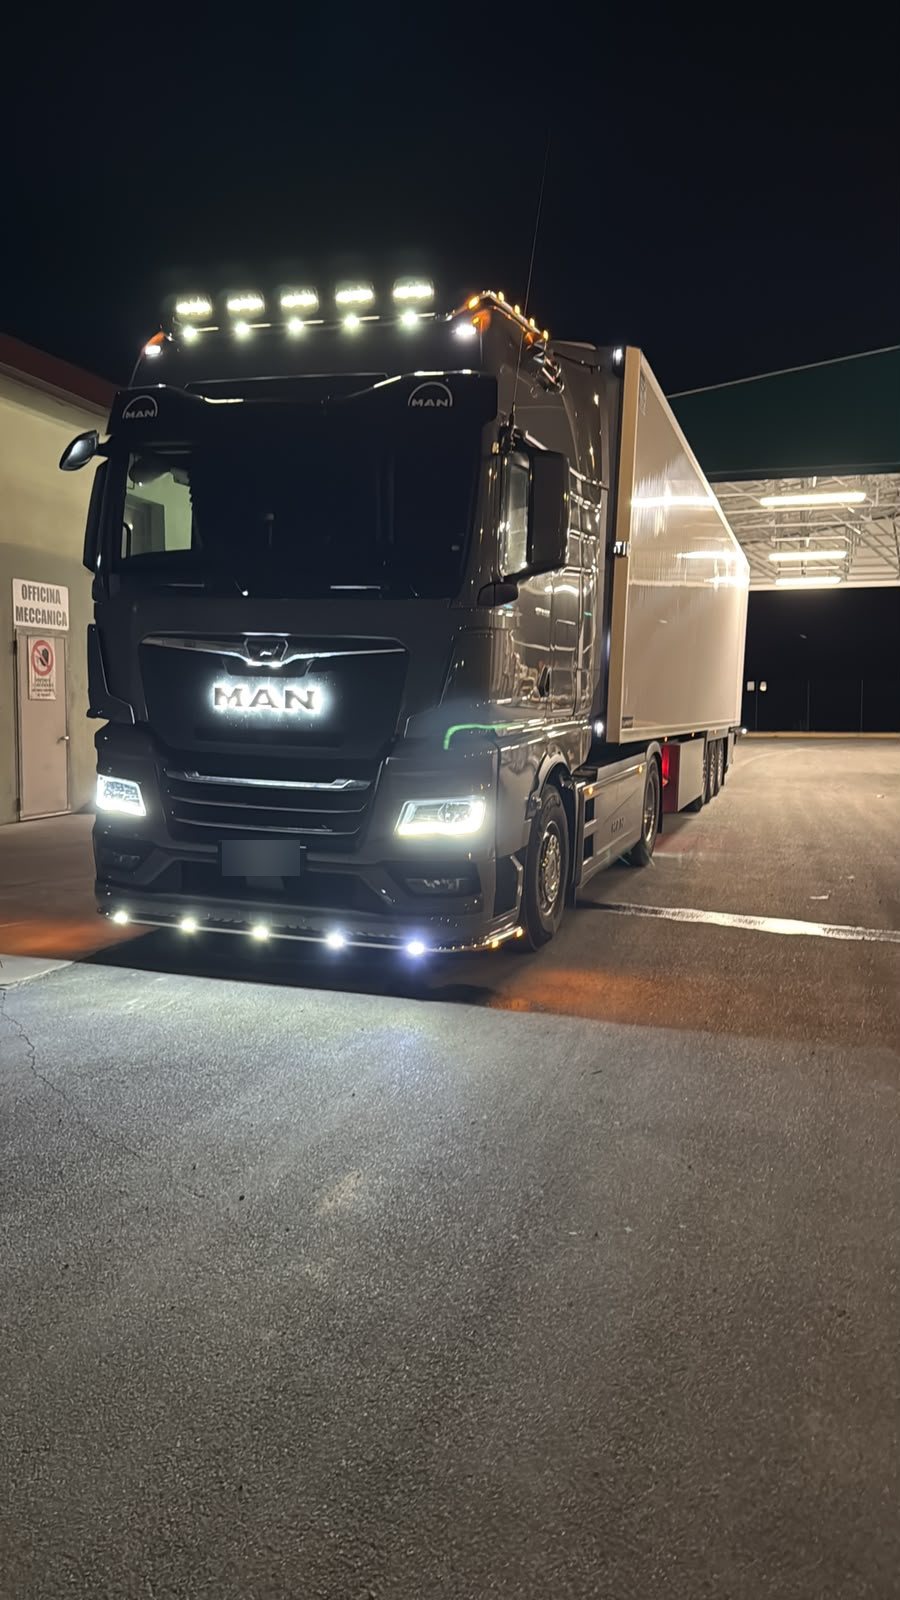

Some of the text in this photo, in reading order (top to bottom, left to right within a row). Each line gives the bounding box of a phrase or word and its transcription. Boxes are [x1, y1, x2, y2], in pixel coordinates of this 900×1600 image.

[412, 398, 449, 407] MAN
[125, 409, 155, 419] MAN
[21, 583, 62, 605] OFFICINA
[15, 605, 68, 627] MECCANICA
[214, 687, 316, 710] MAN
